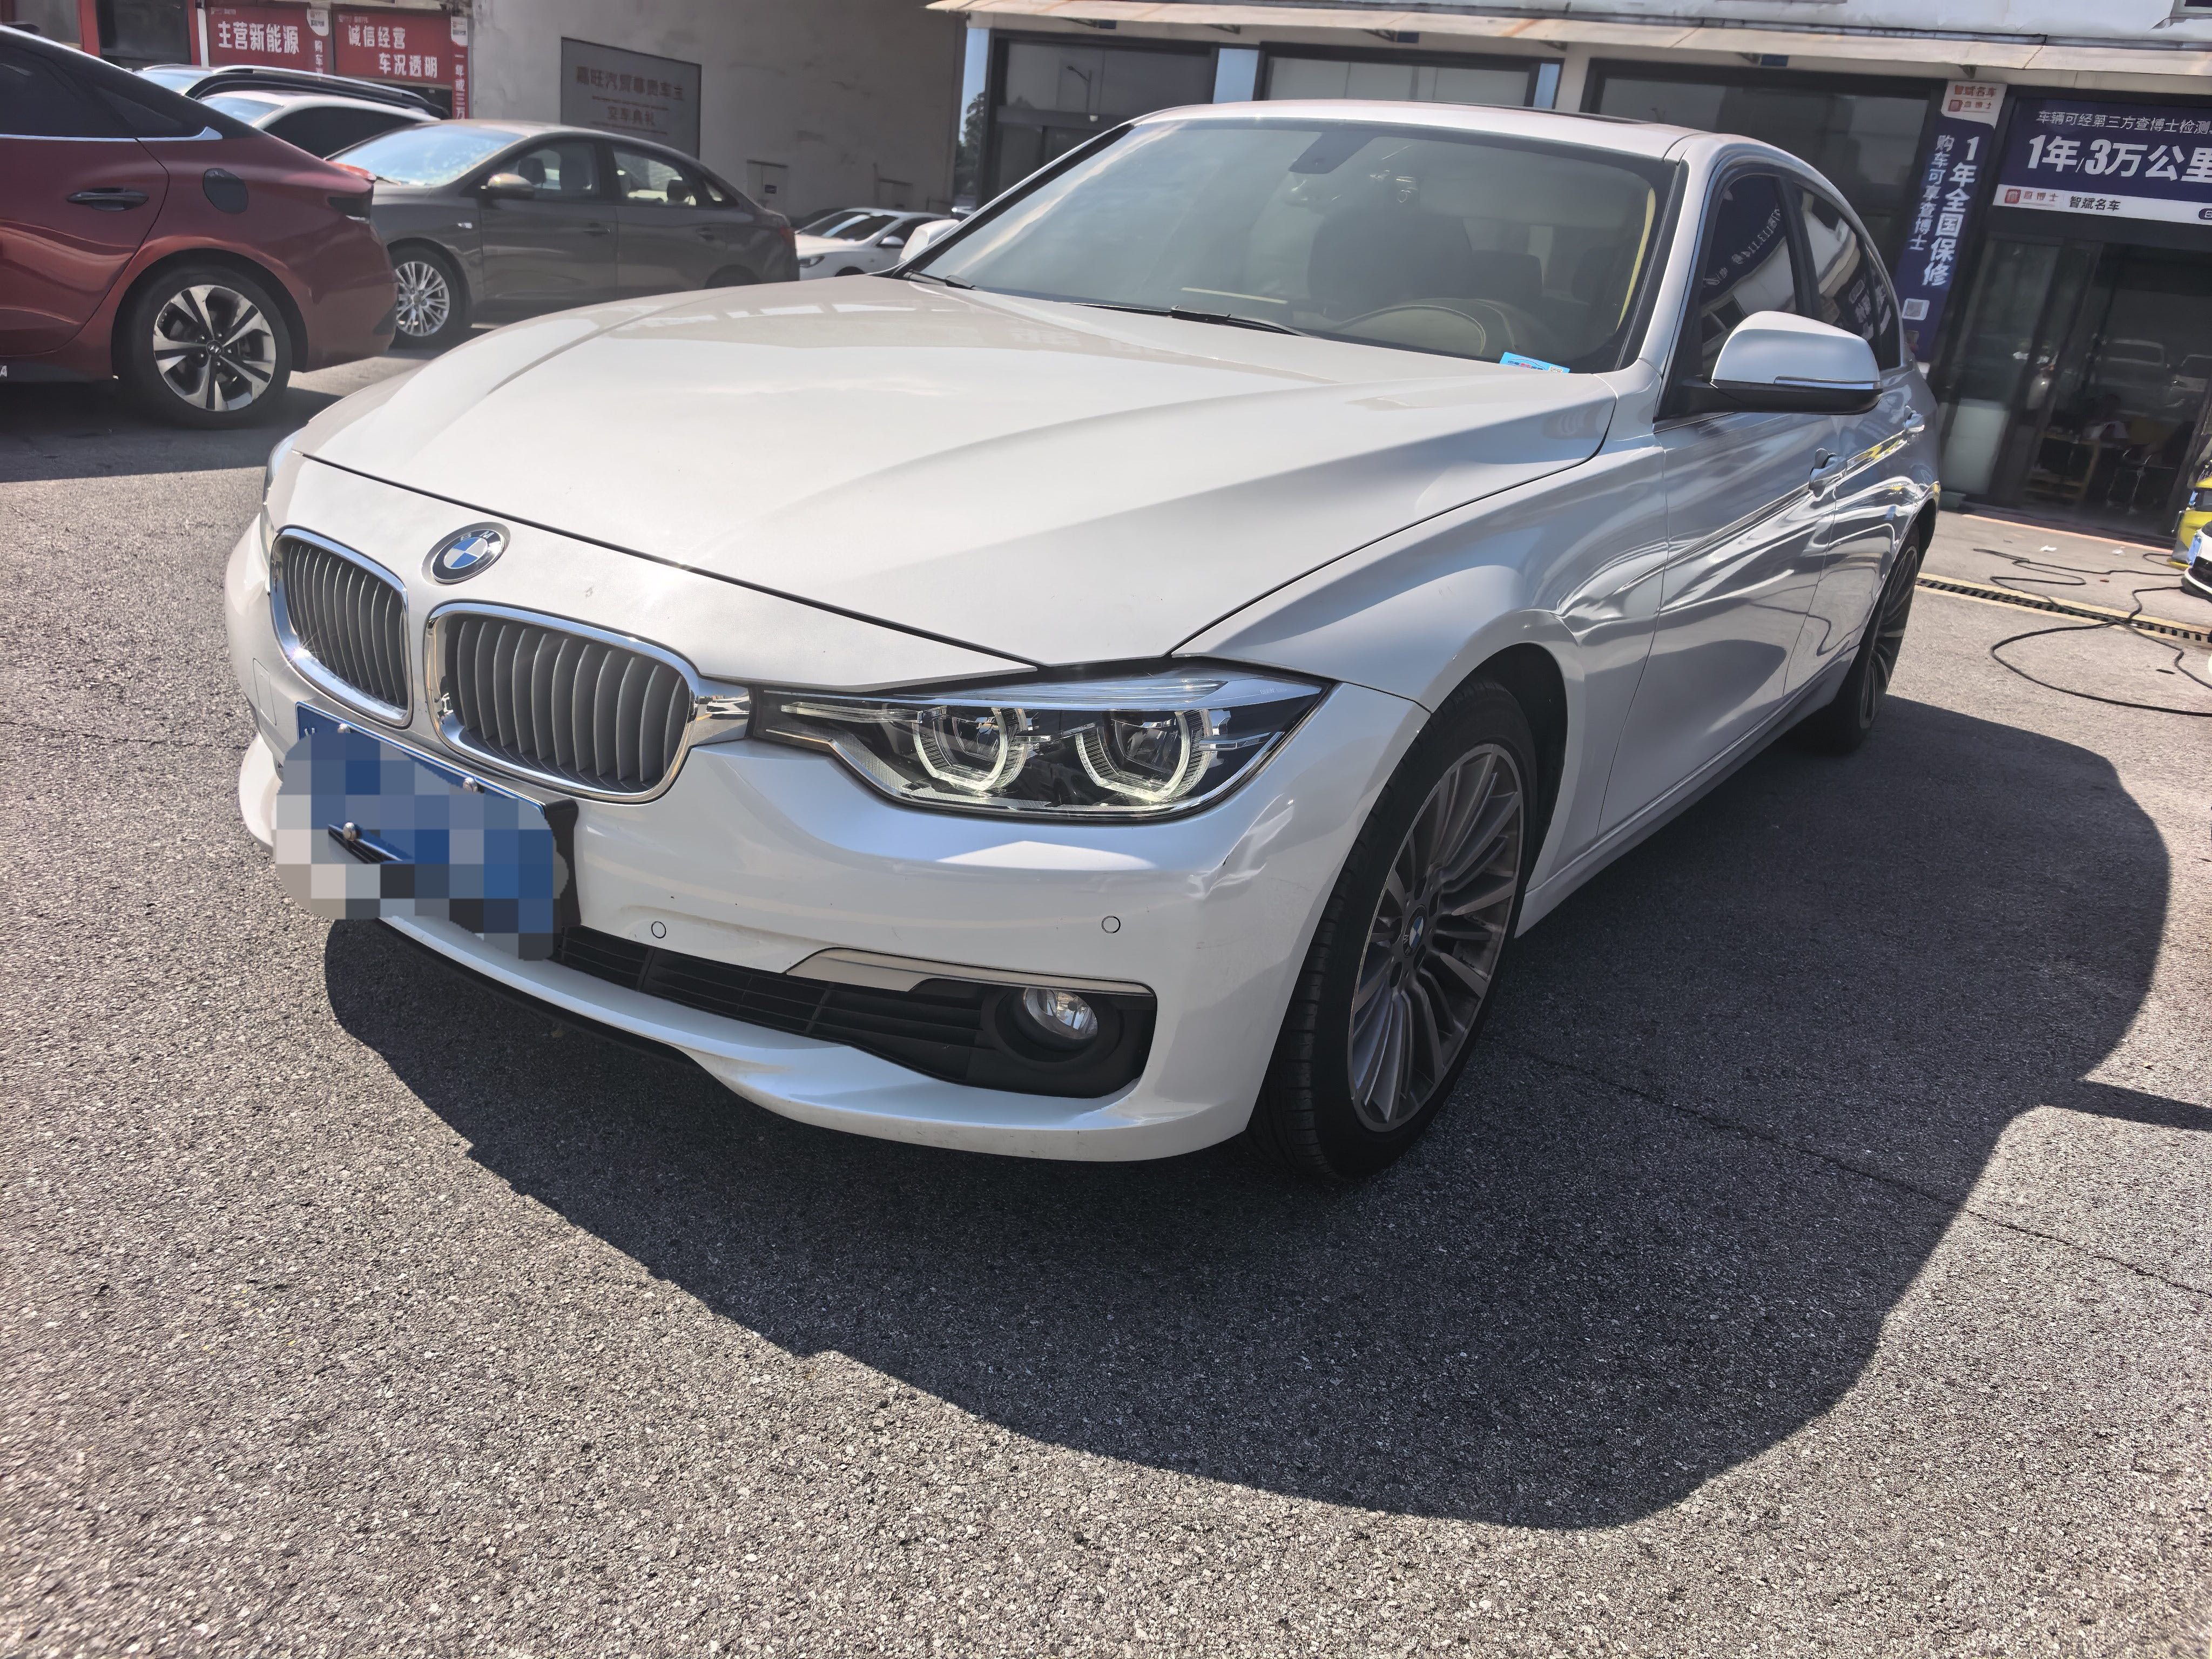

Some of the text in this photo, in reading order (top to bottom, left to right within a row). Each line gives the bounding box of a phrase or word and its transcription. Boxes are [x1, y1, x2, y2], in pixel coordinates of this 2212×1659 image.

[218, 21, 300, 55] 主营新能源
[348, 24, 406, 49] 诚信经营
[379, 52, 437, 78] 车况透明
[2036, 110, 2212, 134] 车辆可经第三方查博士检测
[1921, 136, 1980, 286] 1年全国保修
